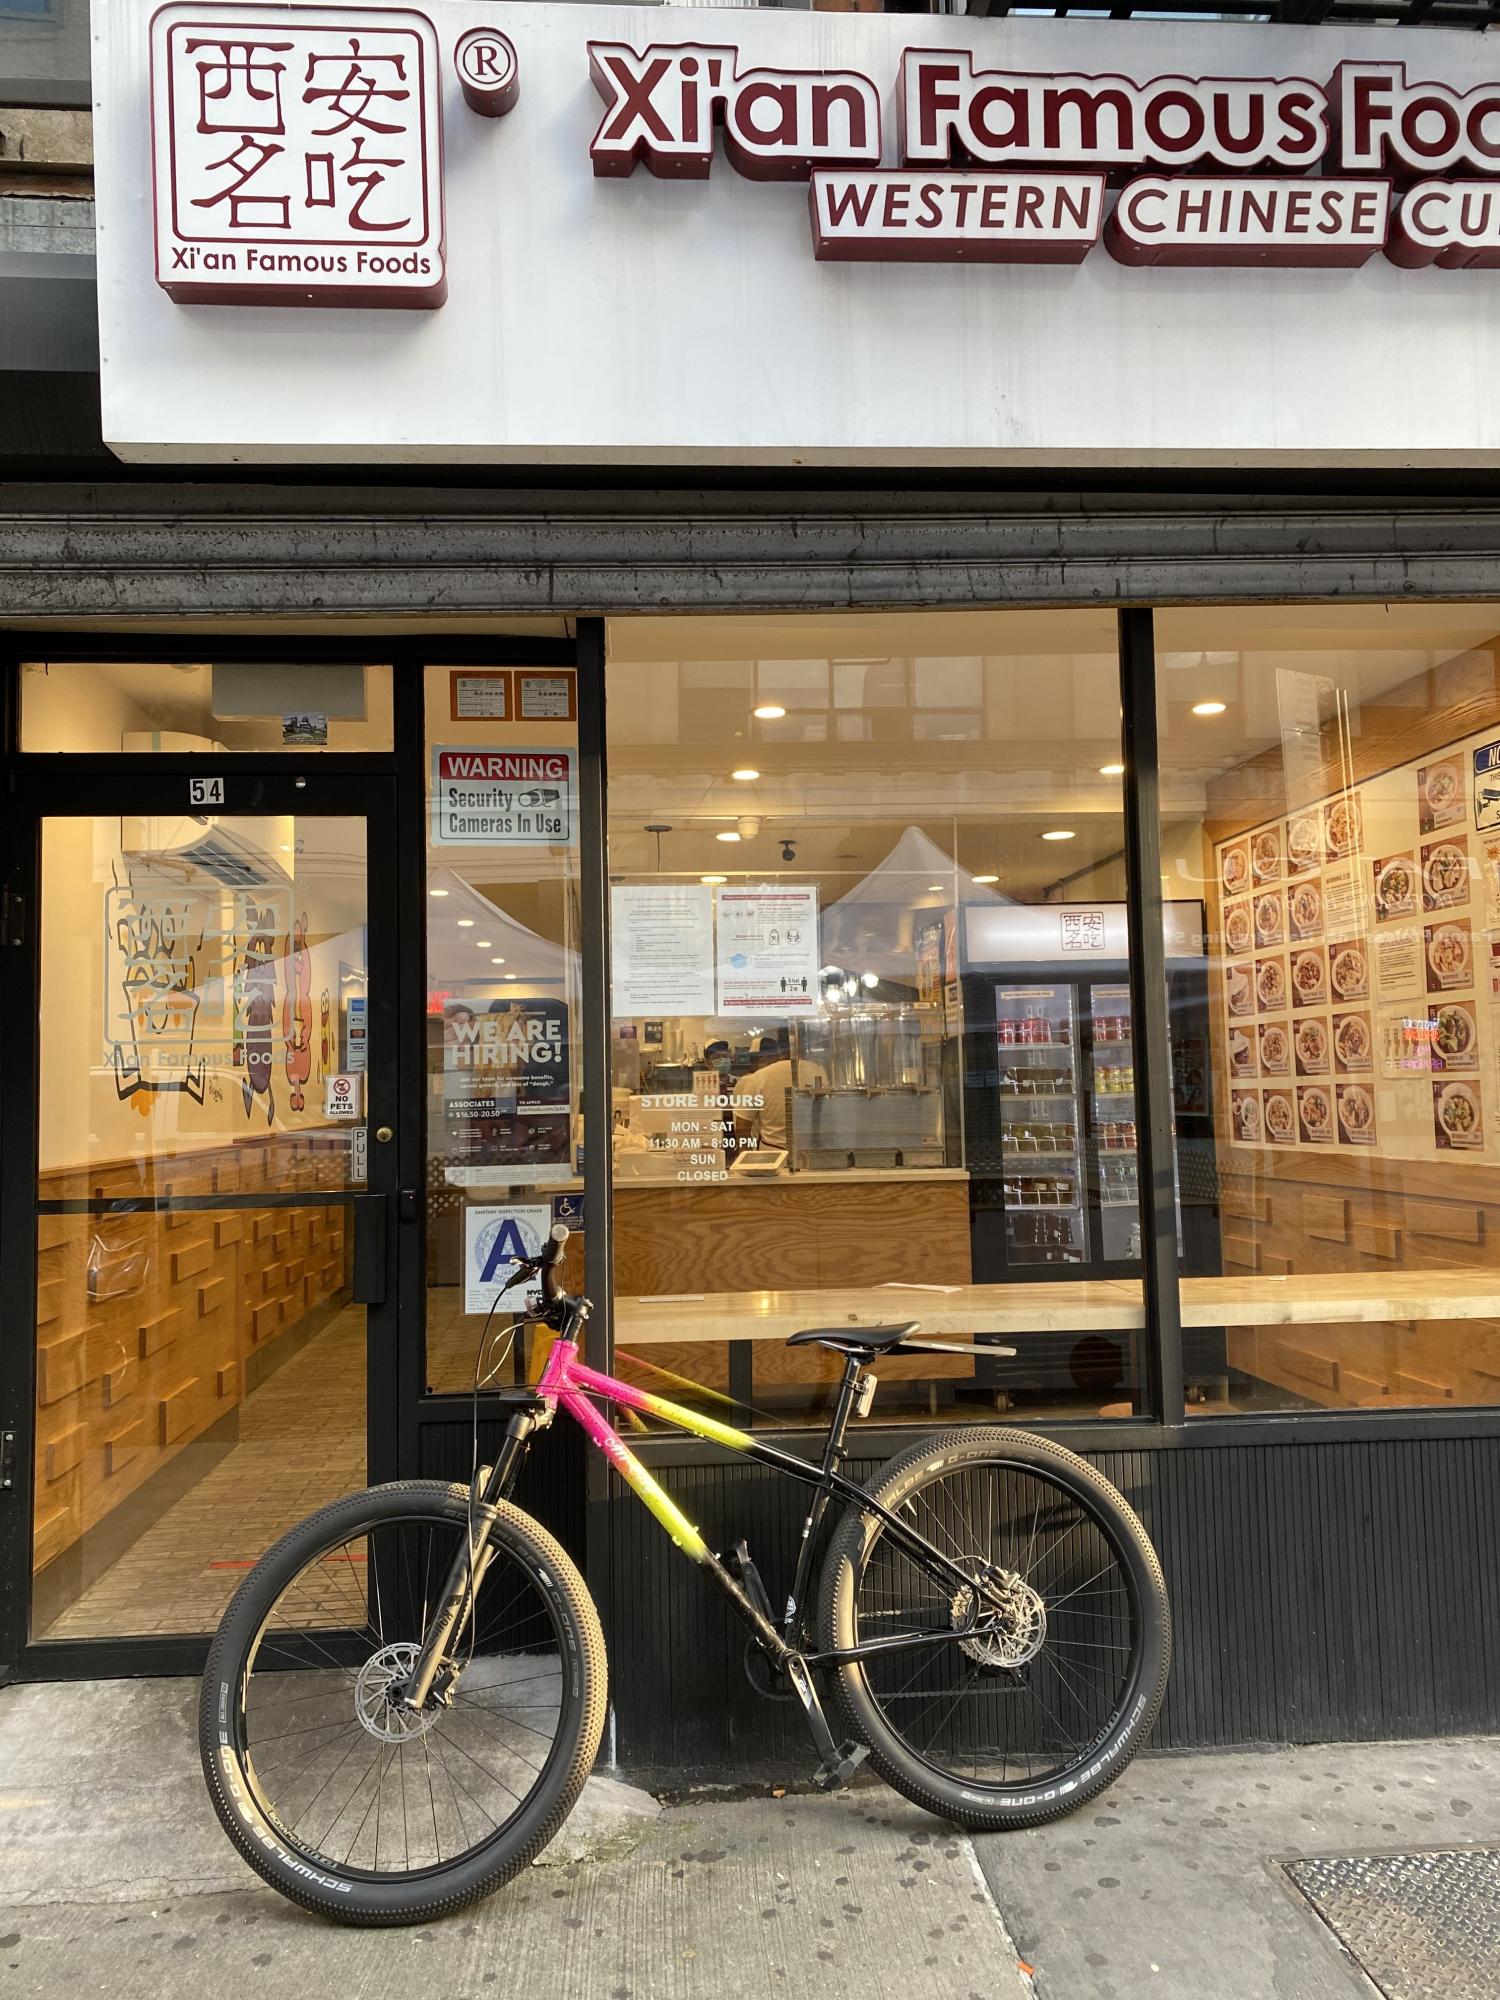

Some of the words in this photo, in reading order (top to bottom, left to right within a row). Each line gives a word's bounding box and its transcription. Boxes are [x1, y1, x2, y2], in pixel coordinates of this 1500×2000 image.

[184, 38, 411, 136] 西安
[602, 56, 867, 149] Xi'an
[918, 64, 1316, 154] Famous
[190, 135, 411, 231] 名吃
[825, 183, 1091, 229] WESTERN
[1127, 189, 1379, 234] CHINESE
[1411, 192, 1500, 236] CU
[171, 247, 236, 271] Xi'an
[247, 249, 348, 273] Famous
[356, 252, 431, 275] Foods
[447, 757, 563, 778] WARNING
[192, 780, 221, 802] 54
[448, 788, 513, 812] Security
[449, 813, 513, 833] Cameras
[517, 814, 531, 833] In
[535, 814, 561, 833] Use
[452, 1021, 498, 1042] WE
[507, 1020, 561, 1041] ARE
[158, 1051, 232, 1066] Famous
[240, 1050, 295, 1065] Foods
[452, 1042, 562, 1064] HIRING!
[449, 1100, 495, 1108] ASSOCIATES
[641, 1095, 698, 1107] STORE
[704, 1095, 764, 1107] HOURS
[671, 1122, 699, 1131] MON
[710, 1121, 734, 1132] SAT
[682, 1138, 700, 1148] AM
[711, 1138, 736, 1148] 8:30
[739, 1138, 757, 1148] PM
[356, 1131, 365, 1178] PULL
[690, 1154, 716, 1165] SUN
[677, 1170, 728, 1181] CLOSED
[479, 1219, 537, 1282] A
[1080, 1693, 1147, 1784] SCHWALBE
[252, 1824, 353, 1893] SCHWALBE
